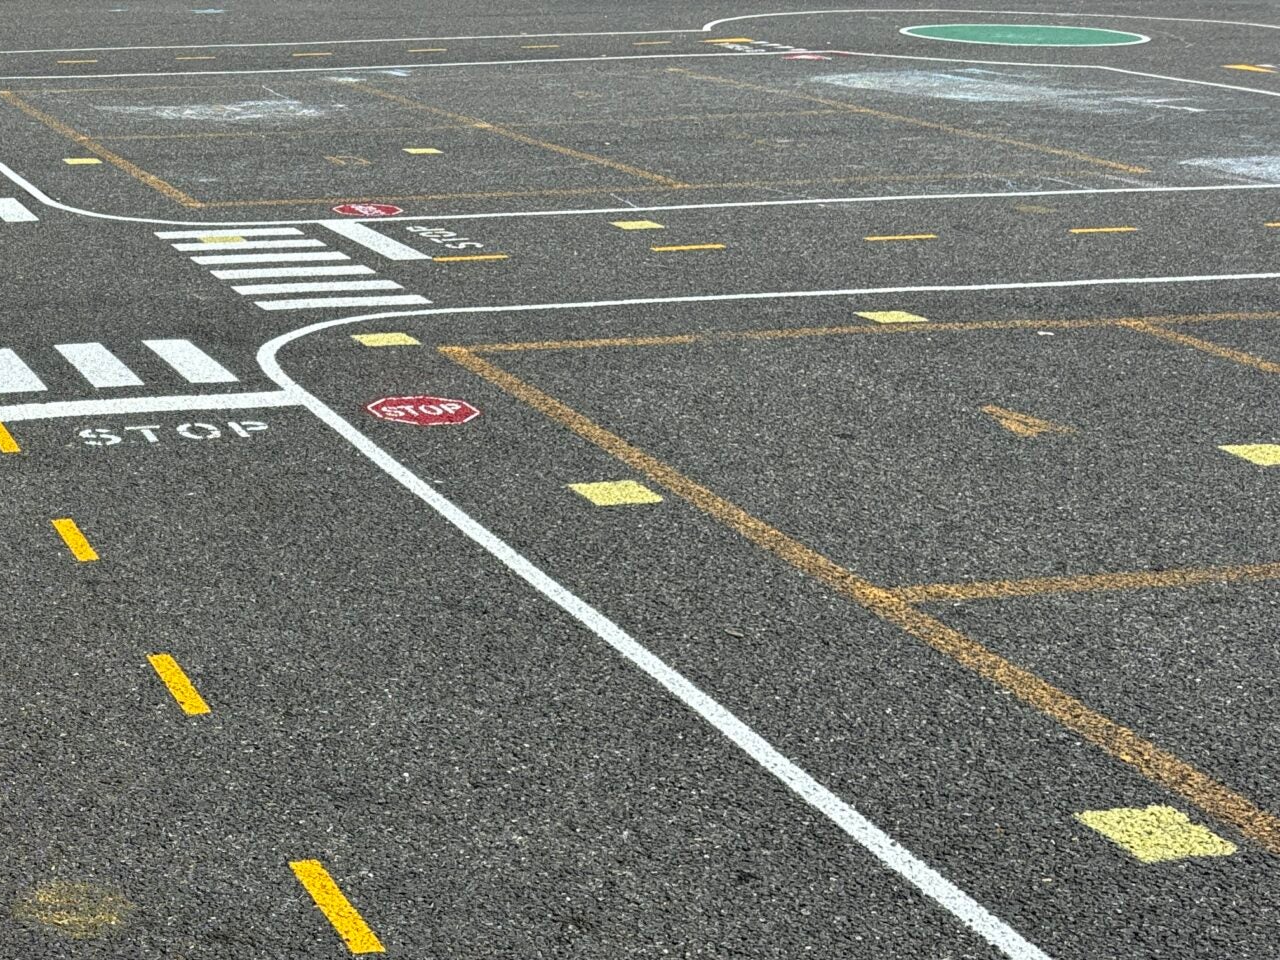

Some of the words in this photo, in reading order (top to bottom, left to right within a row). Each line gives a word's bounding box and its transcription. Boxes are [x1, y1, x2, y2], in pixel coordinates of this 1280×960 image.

[406, 225, 484, 250] STOP
[381, 402, 462, 418] STOP
[78, 420, 269, 447] STOP
